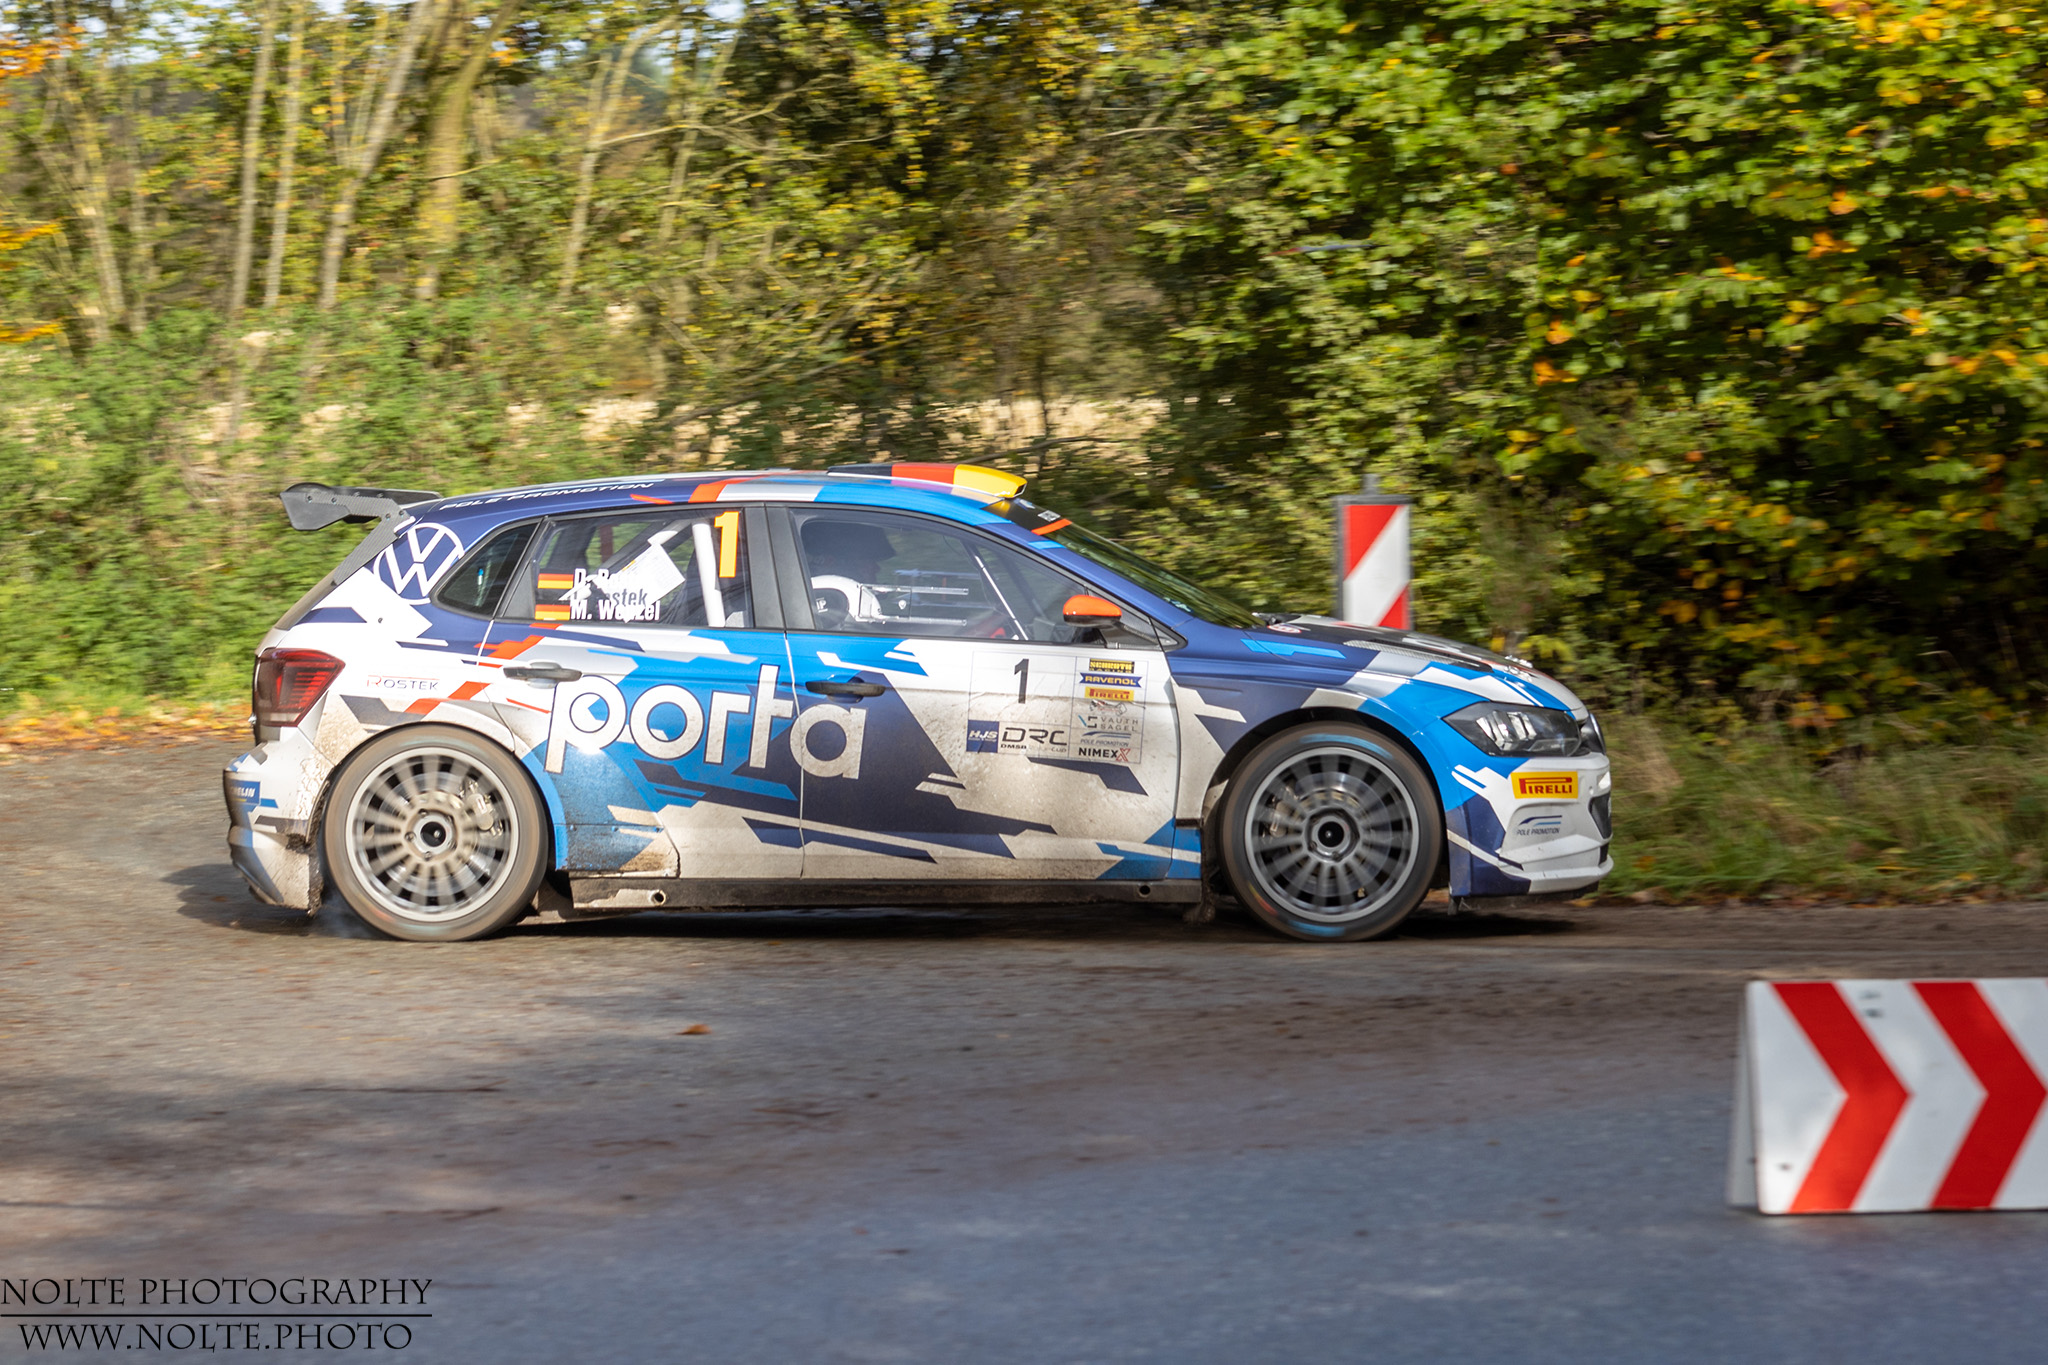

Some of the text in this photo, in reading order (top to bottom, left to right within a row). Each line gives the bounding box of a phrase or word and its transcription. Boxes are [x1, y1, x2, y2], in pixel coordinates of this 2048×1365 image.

[439, 483, 654, 511] POLE PROMOTION
[714, 511, 739, 578] 1
[367, 675, 438, 690] ROSTEK
[1014, 658, 1030, 704] 1
[1085, 675, 1136, 686] RAVENOL
[1089, 688, 1130, 700] PIRELLI
[544, 664, 866, 779] porta
[1101, 716, 1139, 725] VAUTH
[1101, 723, 1137, 732] SAGEL
[968, 727, 1068, 746] HJS DRC
[1095, 739, 1130, 747] PROMOTION
[1519, 777, 1573, 794] PIRELLI
[1531, 827, 1560, 835] PROMOTION
